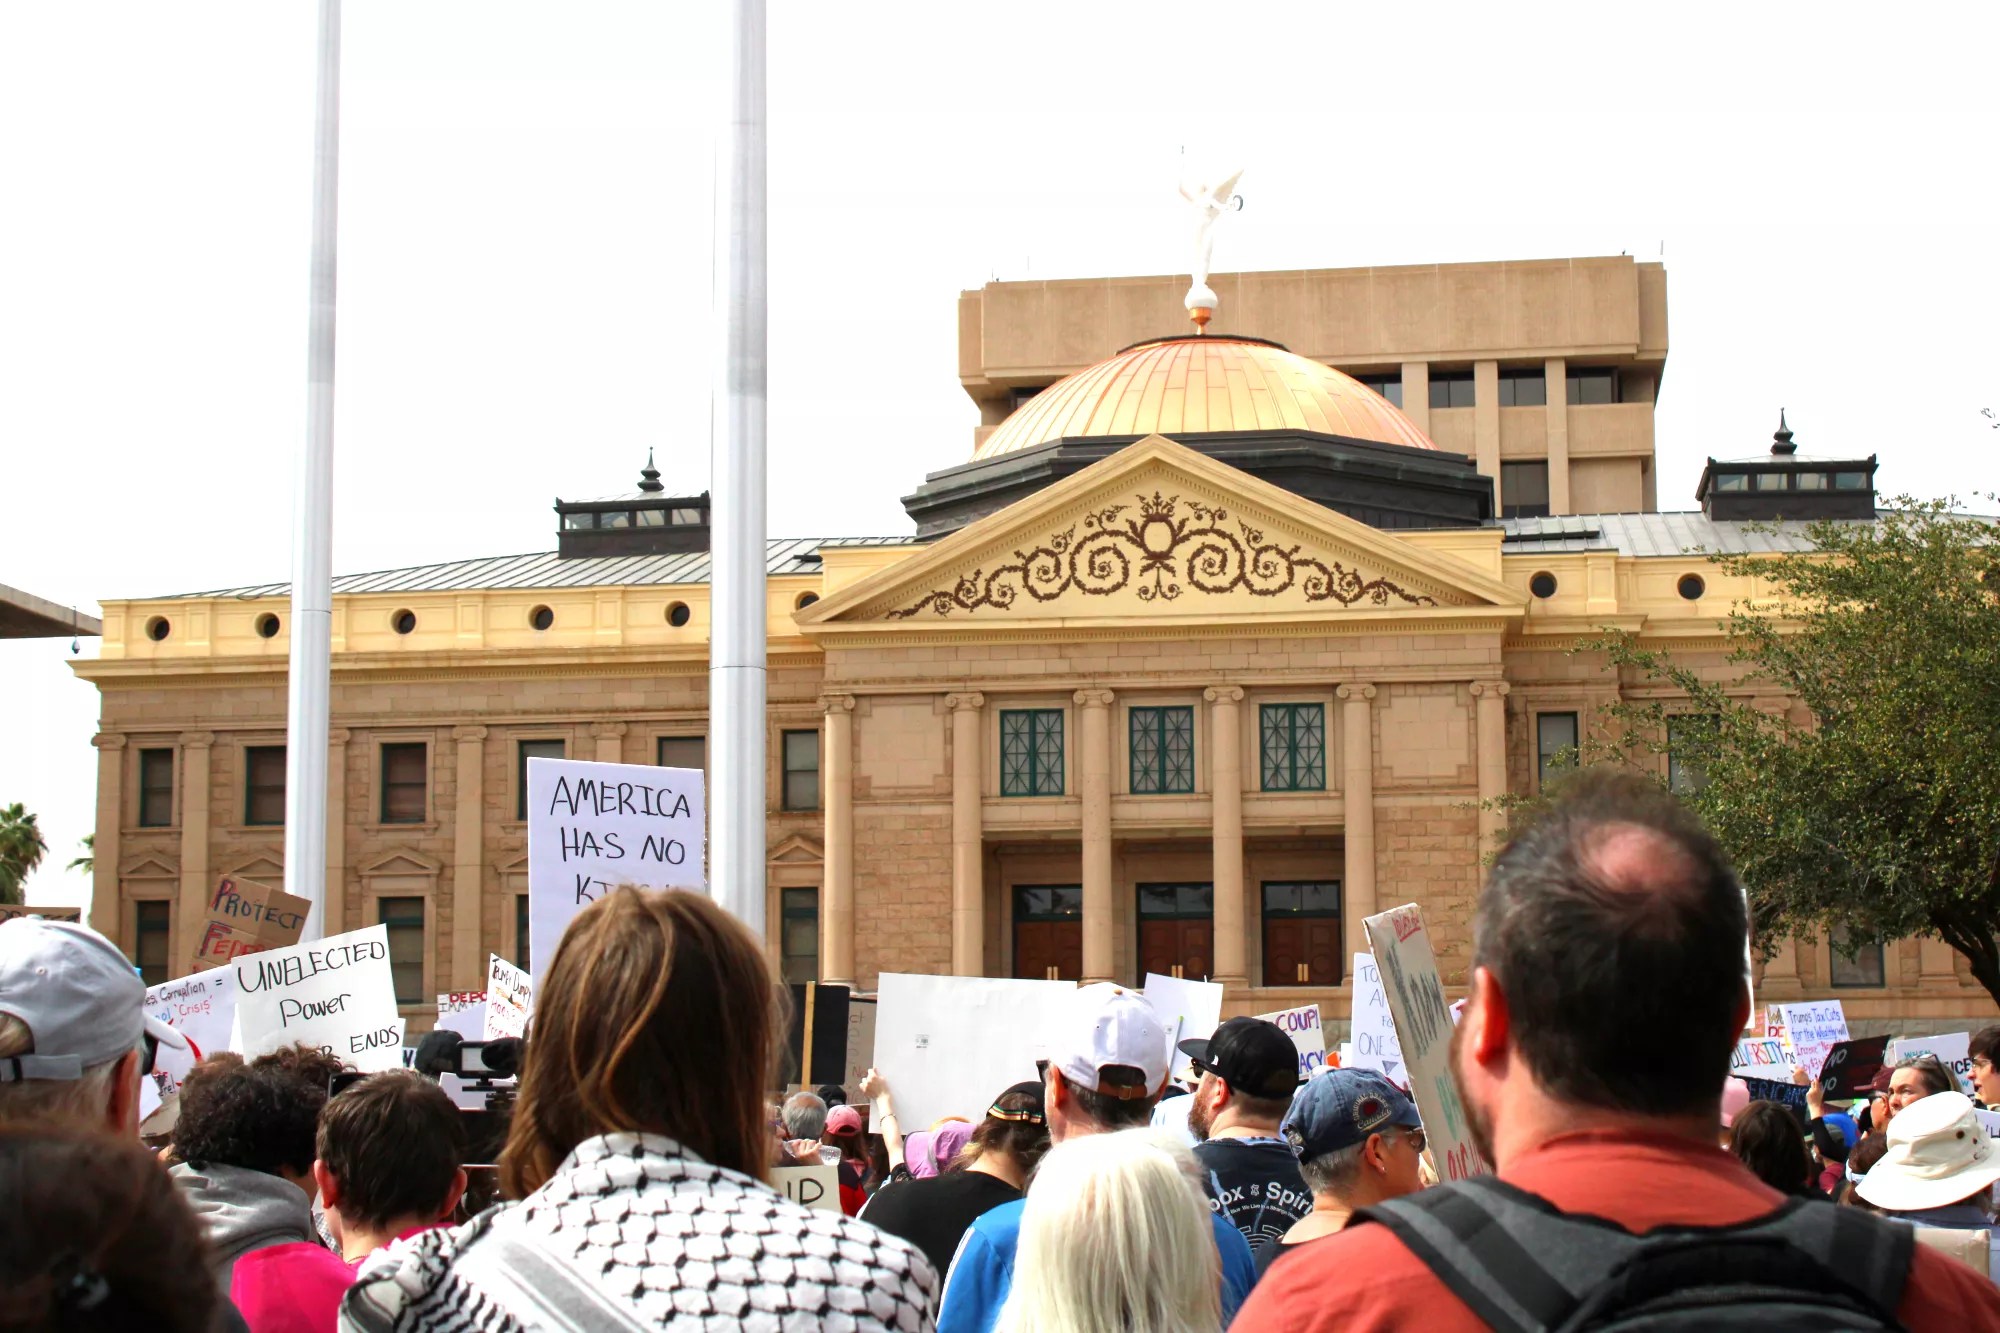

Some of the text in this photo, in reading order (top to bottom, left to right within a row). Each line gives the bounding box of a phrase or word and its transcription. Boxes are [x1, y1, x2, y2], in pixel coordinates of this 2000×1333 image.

[550, 776, 690, 818] AMERICA
[561, 826, 685, 865] HAS NO
[211, 879, 304, 930] PROTECT
[237, 942, 385, 992] UNELECTED
[159, 981, 205, 1002] Corruption
[279, 993, 351, 1027] Power
[1275, 1009, 1319, 1032] COUP!
[1811, 1008, 1825, 1022] Tax
[350, 1025, 399, 1053] ENDS
[1358, 1032, 1384, 1056] ONE
[1791, 1027, 1802, 1041] for
[1803, 1028, 1814, 1040] the
[1825, 1048, 1847, 1069] NO
